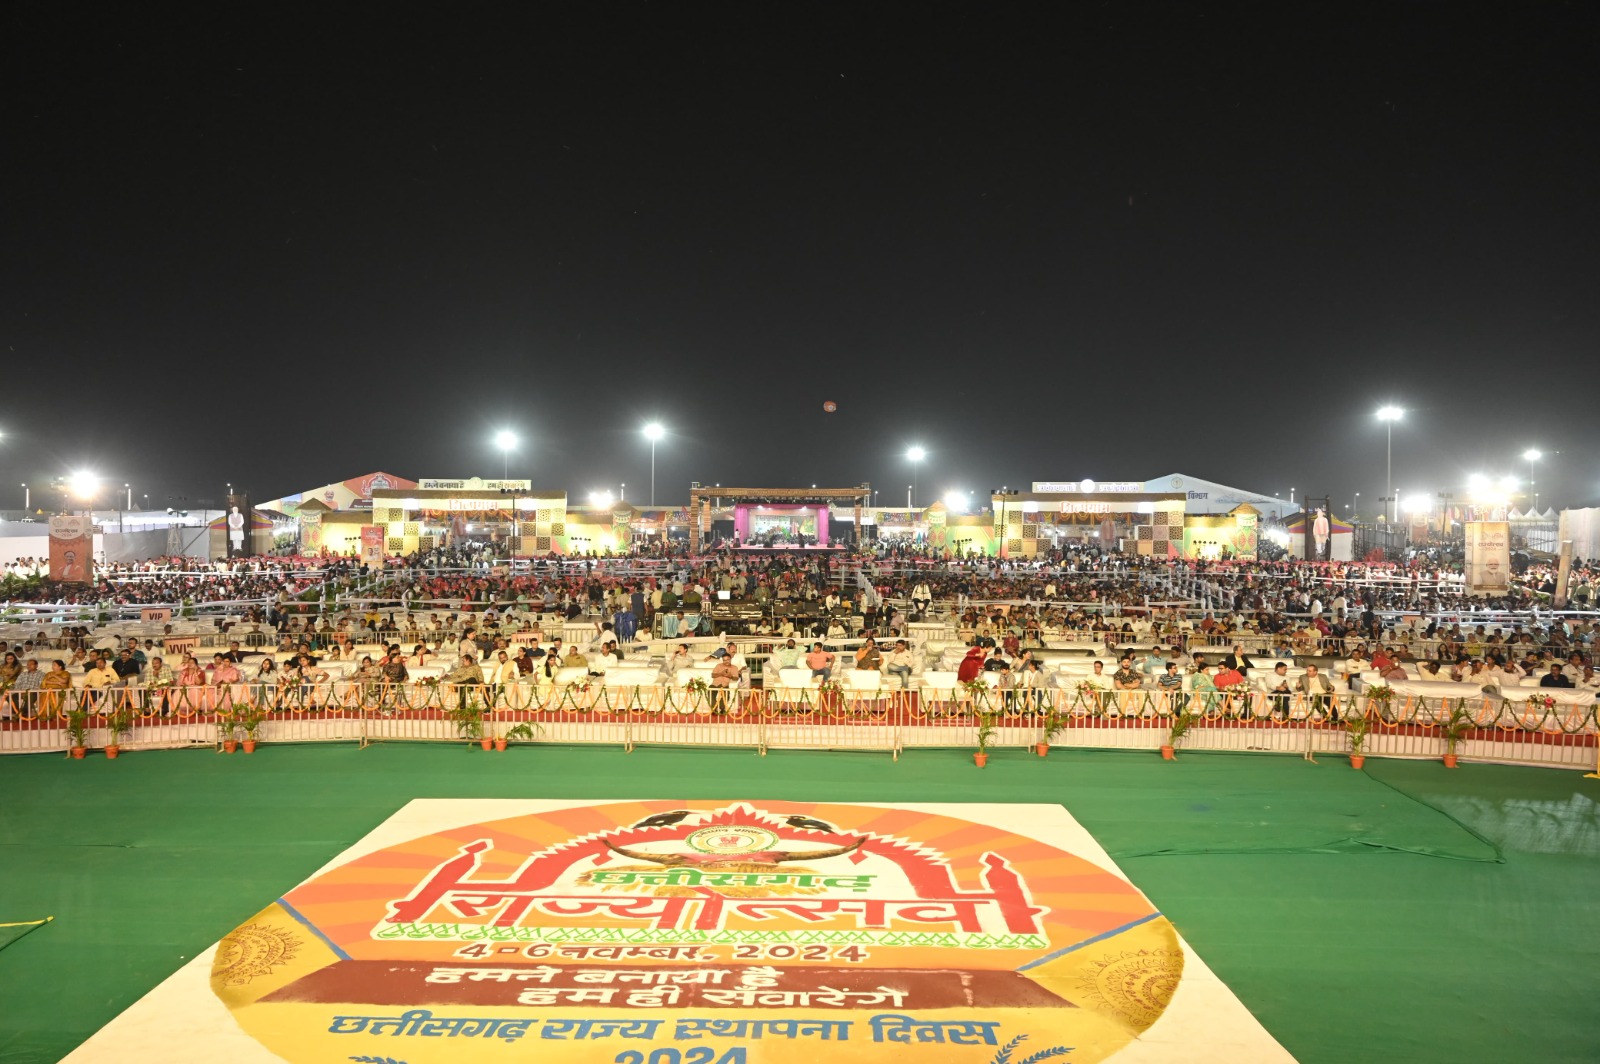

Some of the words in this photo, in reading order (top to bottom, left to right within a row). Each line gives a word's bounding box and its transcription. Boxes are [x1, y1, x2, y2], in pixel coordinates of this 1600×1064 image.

[1187, 491, 1209, 500] विभाग
[149, 612, 163, 620] VIP
[592, 868, 878, 892] छत्तीसगढ़
[450, 884, 990, 933] राज्योत्सव
[737, 945, 867, 962] 2024
[425, 965, 563, 984] हमने
[573, 968, 732, 985] बनाया
[741, 966, 784, 987] है
[517, 987, 620, 1006] हम
[627, 986, 683, 1007] ही
[328, 1010, 538, 1042] छत्तीसगढ़
[540, 1019, 665, 1040] राज्य
[674, 1018, 854, 1041] स्थापना
[868, 1014, 1001, 1046] दिवस
